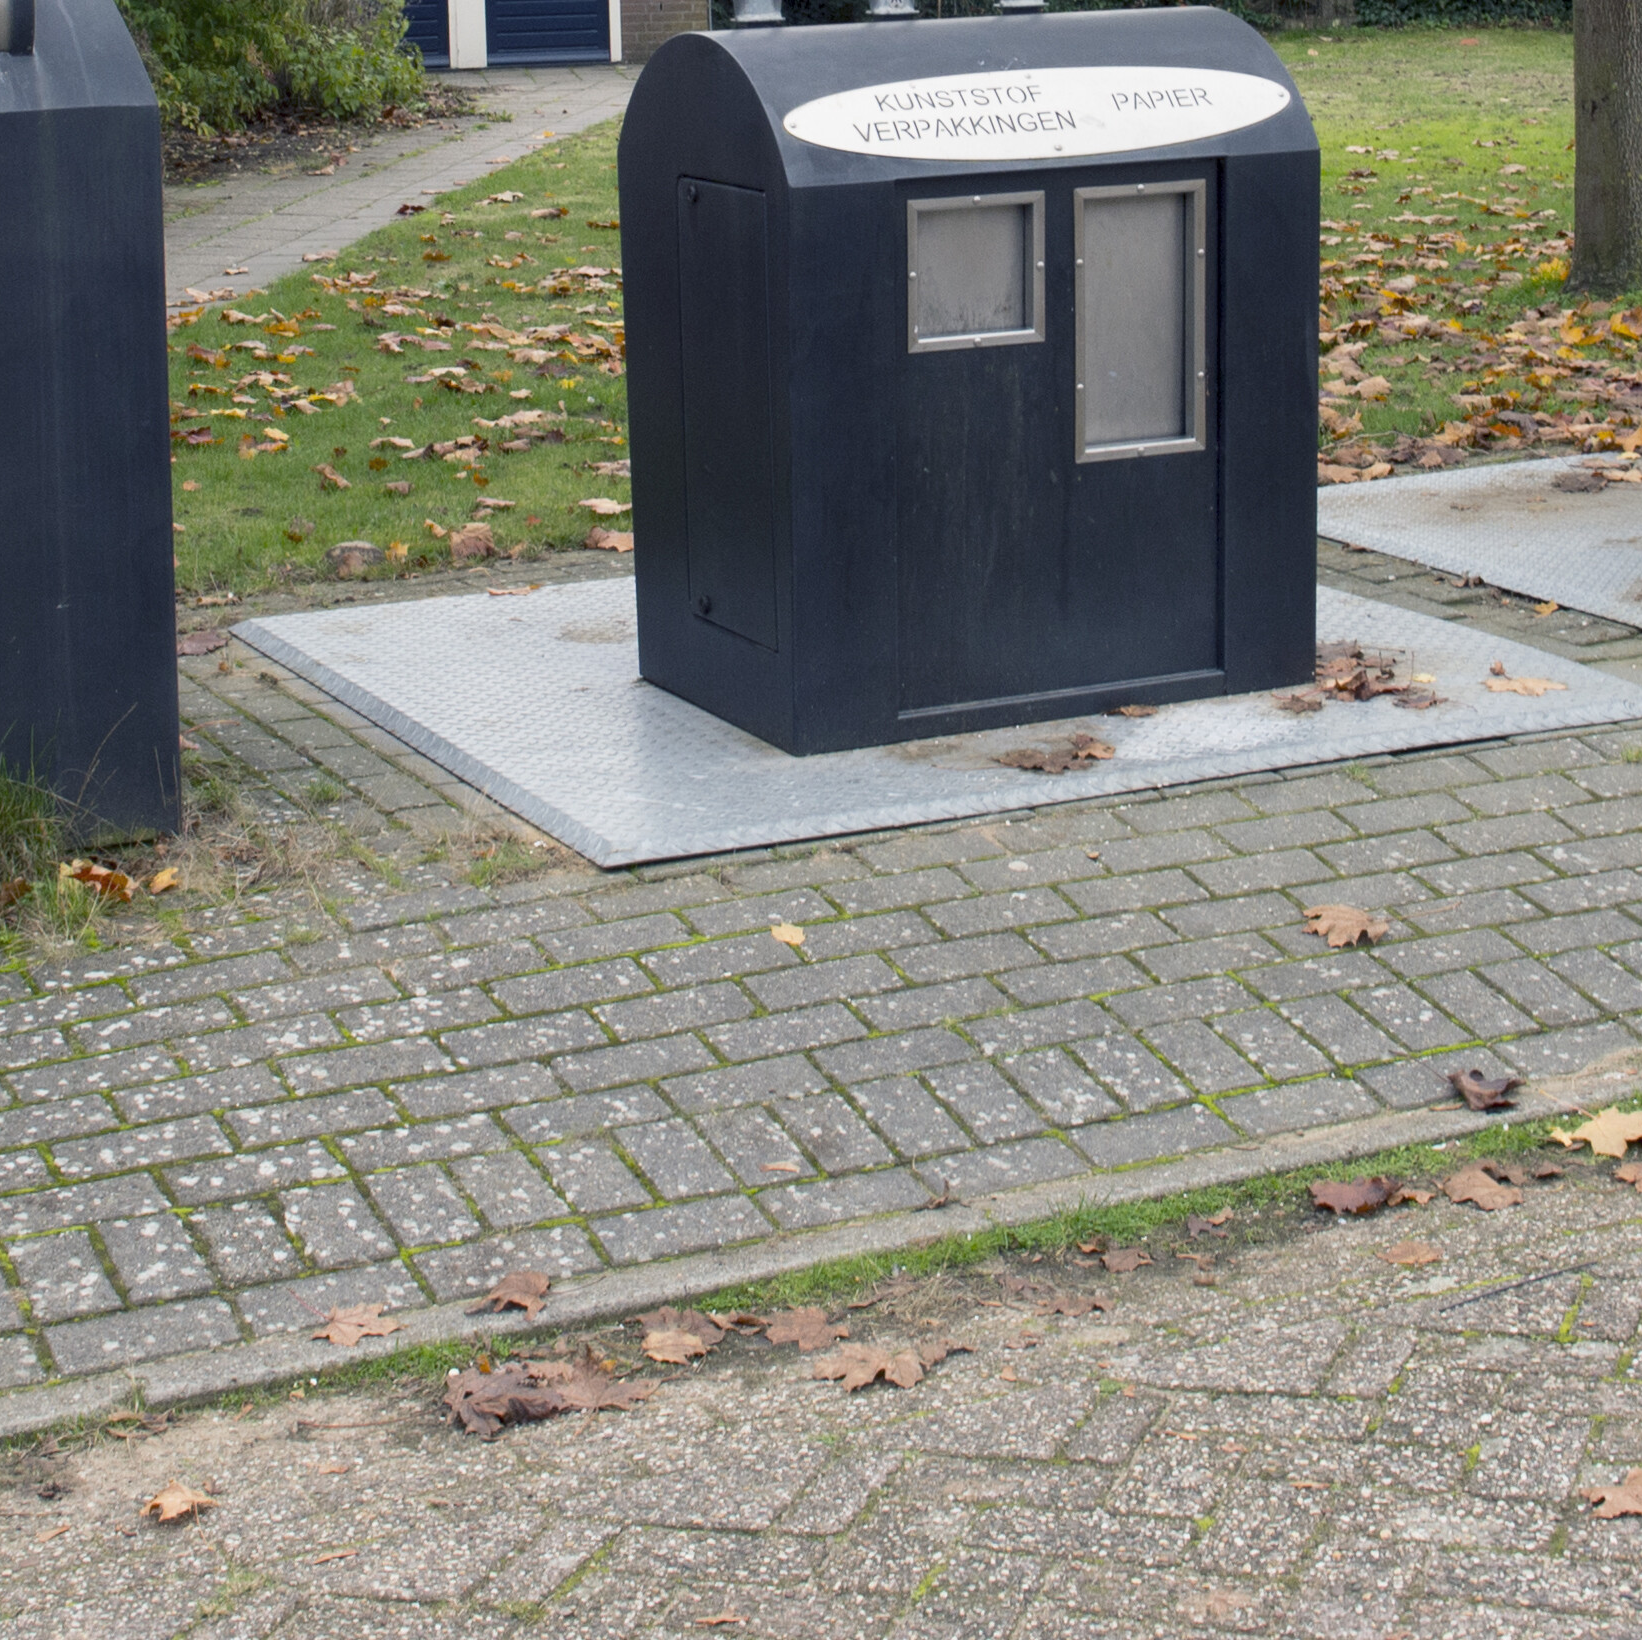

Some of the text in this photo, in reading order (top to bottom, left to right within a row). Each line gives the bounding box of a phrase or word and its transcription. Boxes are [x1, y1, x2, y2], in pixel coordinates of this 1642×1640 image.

[874, 84, 1042, 112] KUNSTSTOF
[1110, 86, 1213, 112] PAPIER
[852, 109, 1078, 144] VERPAKKINGEN
